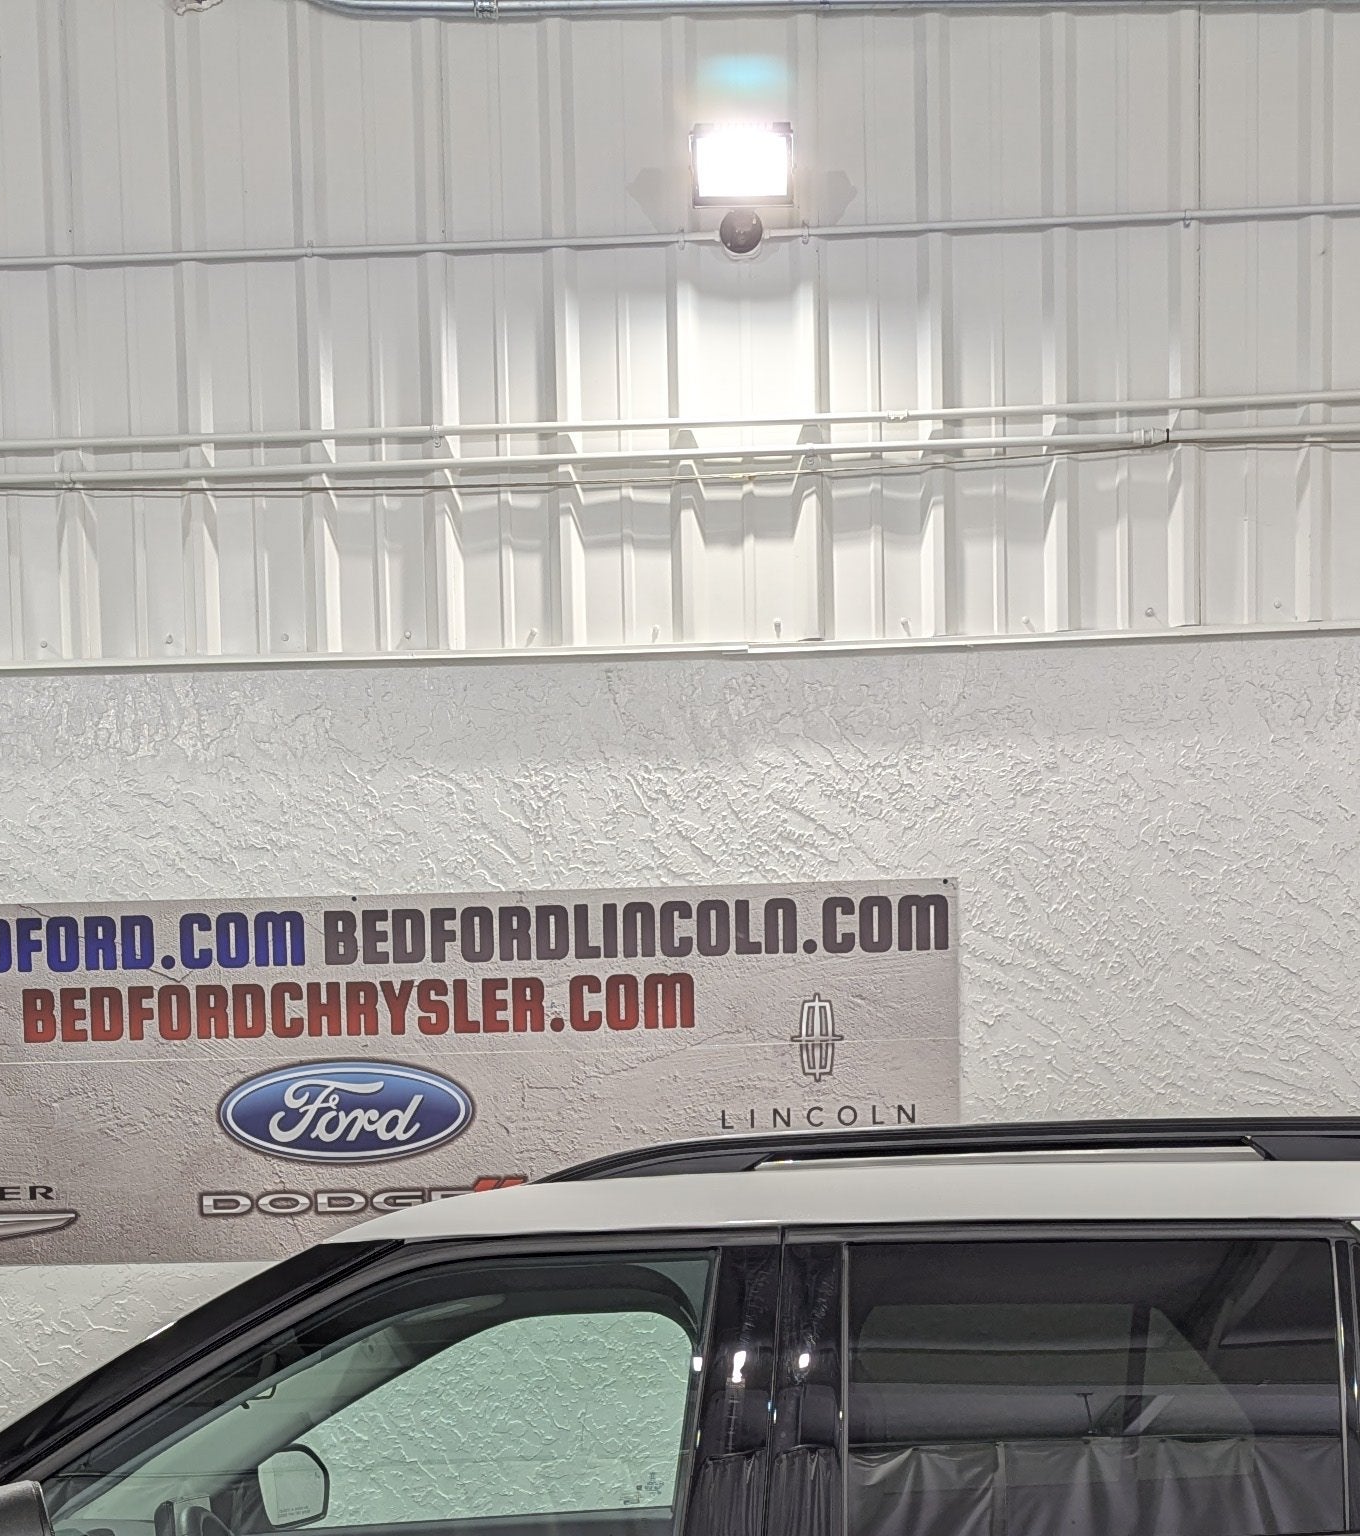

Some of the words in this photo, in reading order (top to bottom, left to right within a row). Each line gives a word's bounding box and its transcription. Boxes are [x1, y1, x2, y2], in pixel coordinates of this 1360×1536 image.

[323, 894, 949, 965] BEDFORDLINCOLN.COM
[22, 972, 696, 1044] BEDFORDCHRYSLER.COM
[268, 1079, 423, 1143] Ford
[721, 1104, 915, 1130] LINCOLN
[201, 1188, 474, 1216] DODG
